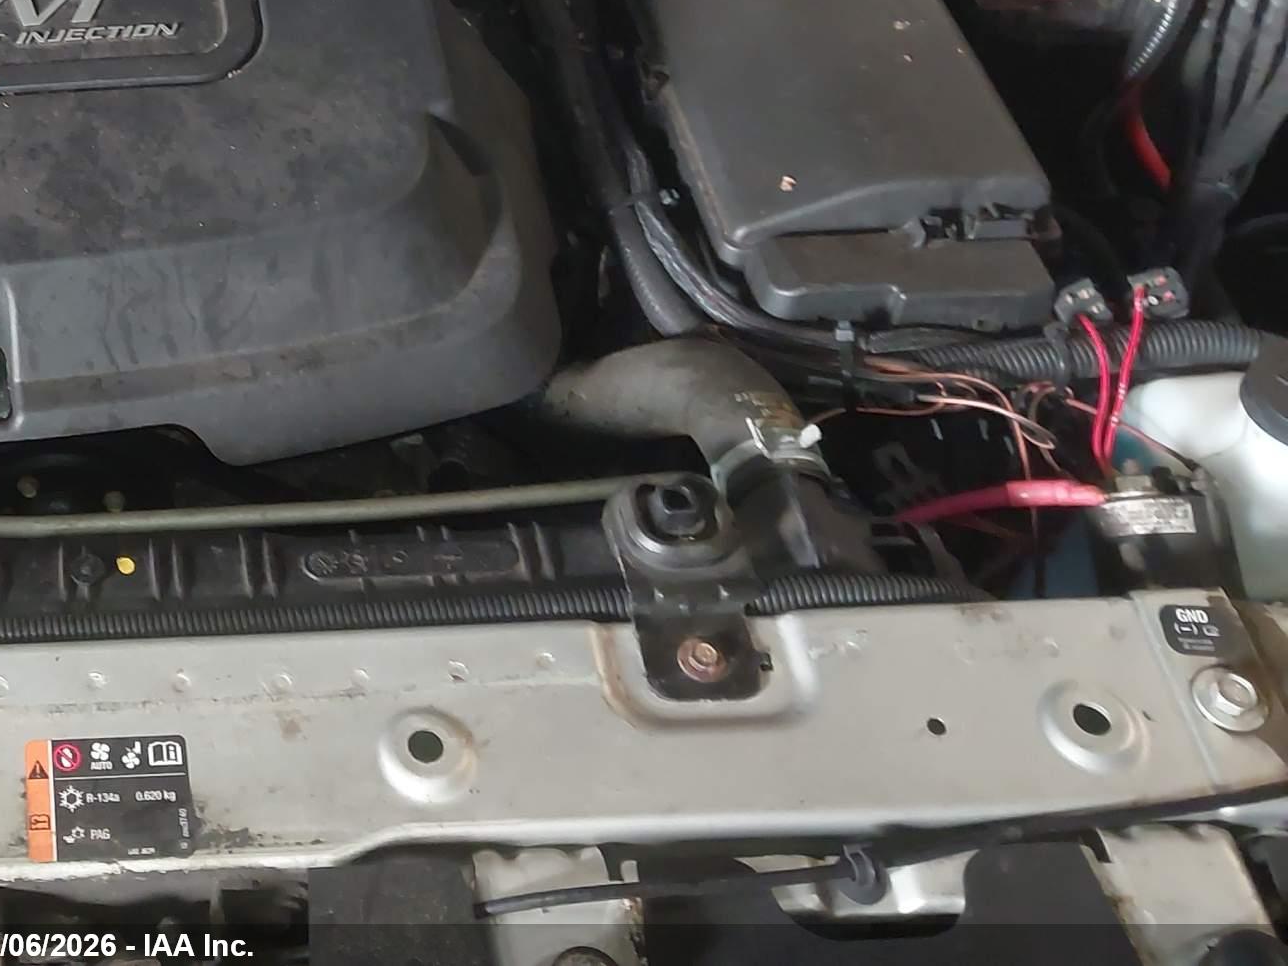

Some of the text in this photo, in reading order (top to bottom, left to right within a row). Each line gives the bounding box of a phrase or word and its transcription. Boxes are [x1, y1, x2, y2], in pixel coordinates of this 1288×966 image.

[16, 22, 179, 45] INJECTION
[1175, 608, 1209, 624] GND
[90, 761, 113, 771] AUTO
[86, 789, 177, 804] R-134a 0.620 kg
[90, 829, 111, 841] PAG
